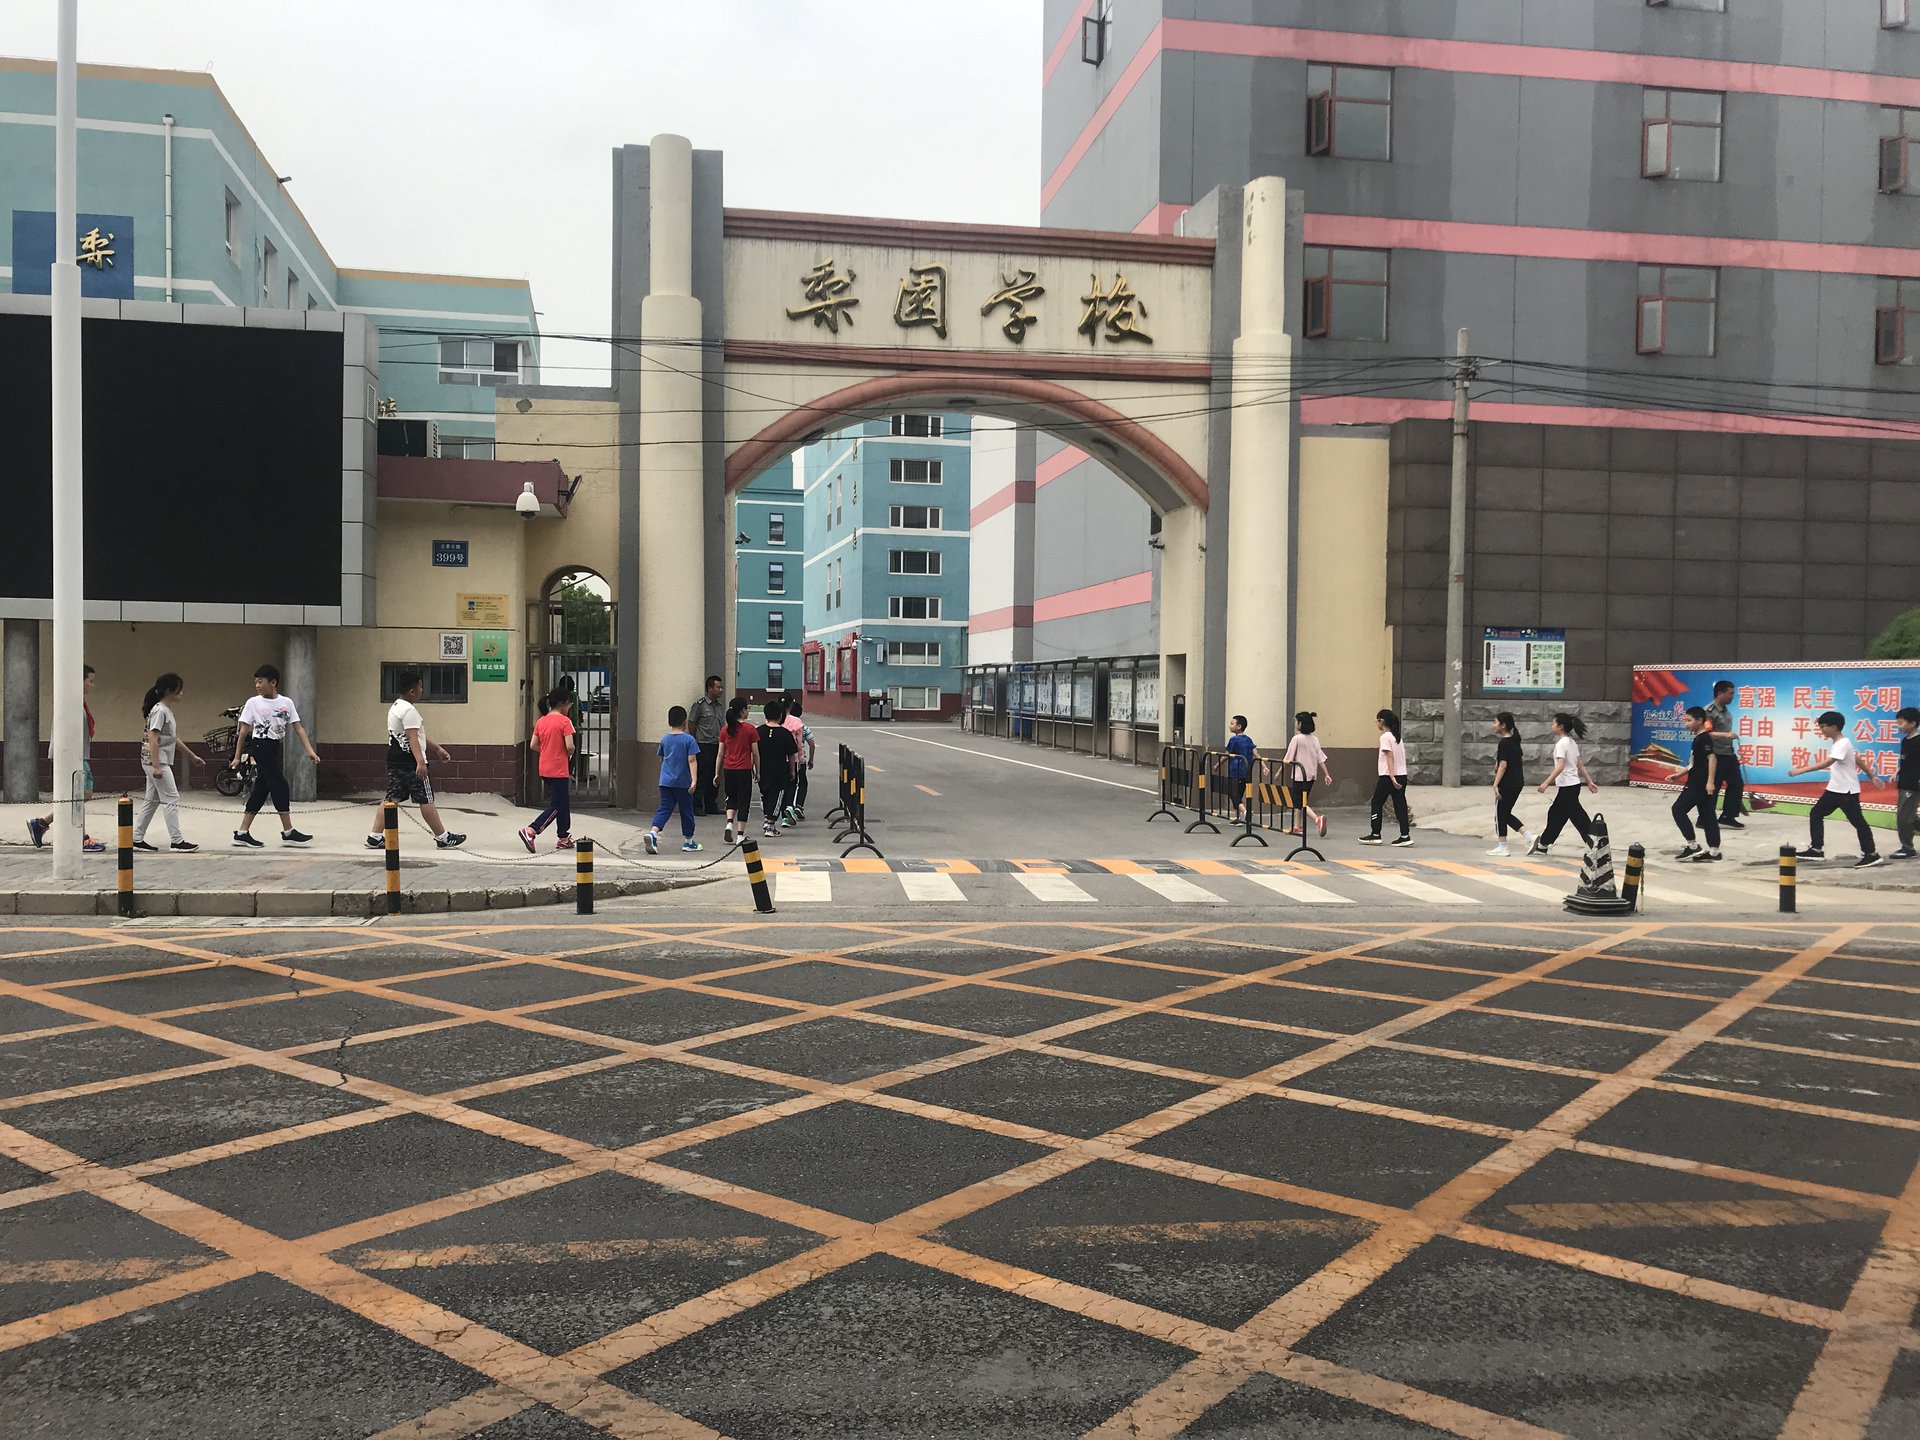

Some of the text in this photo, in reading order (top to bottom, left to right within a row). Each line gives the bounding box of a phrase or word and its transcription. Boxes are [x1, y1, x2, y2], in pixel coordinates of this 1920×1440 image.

[76, 227, 115, 270] 梨
[436, 552, 465, 563] 399号
[1738, 686, 1901, 712] 富强 民主 文明
[1739, 715, 1774, 738] 自由
[1853, 718, 1901, 743] 公正
[1737, 744, 1774, 768] 爱国
